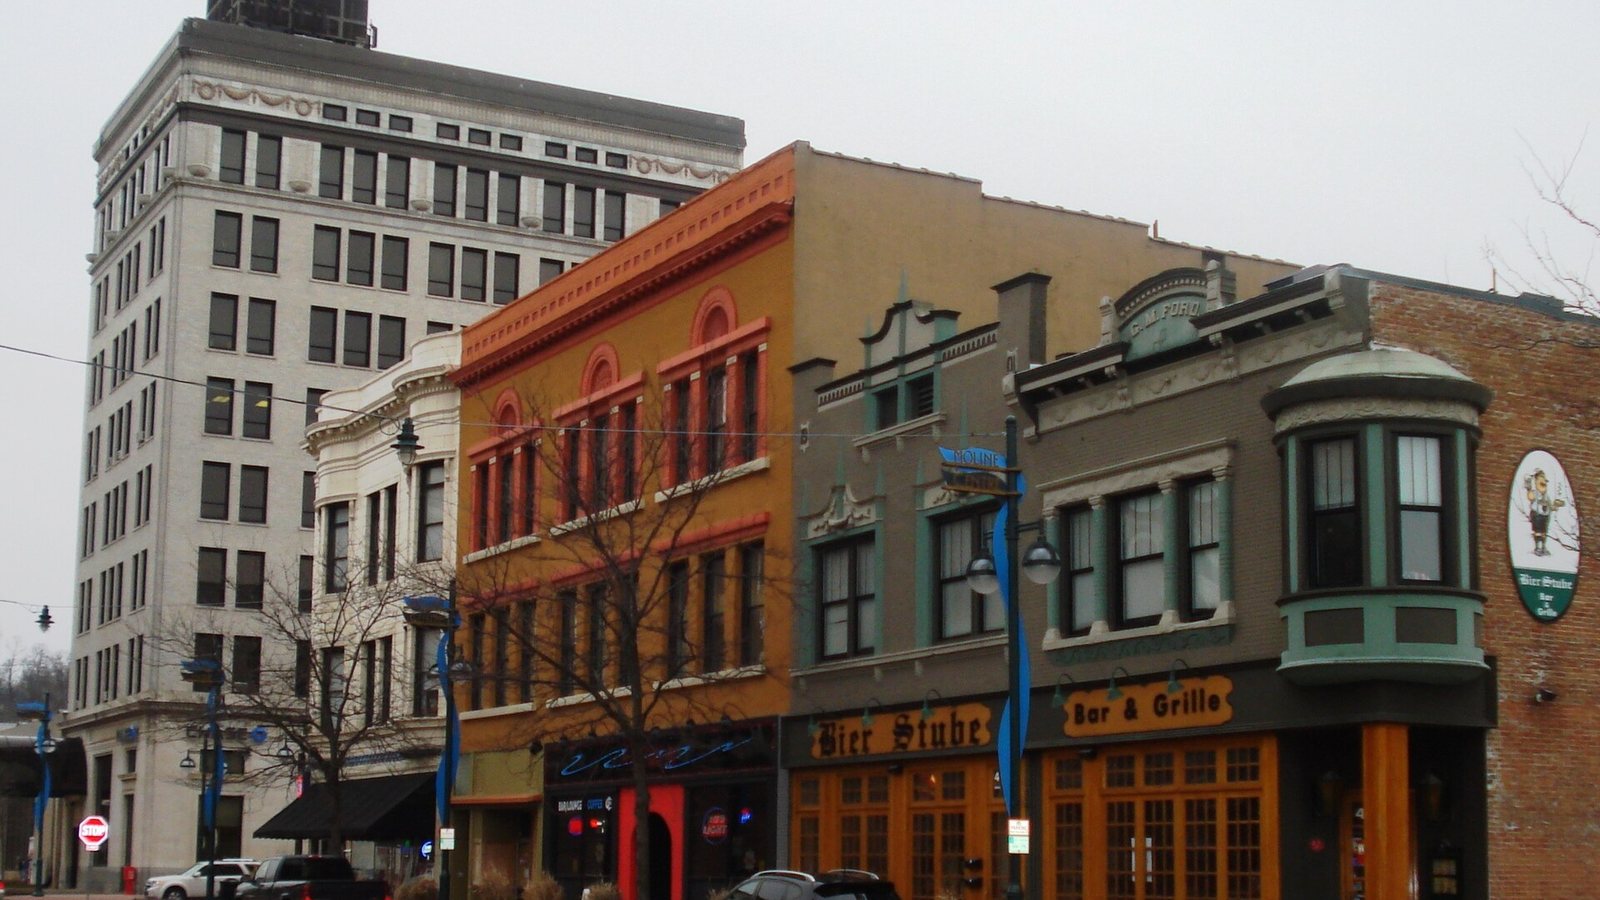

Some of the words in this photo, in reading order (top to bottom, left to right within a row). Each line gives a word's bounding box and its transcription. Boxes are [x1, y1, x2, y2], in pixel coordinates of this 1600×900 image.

[954, 450, 999, 467] MOLINE
[1519, 573, 1541, 587] Bier
[1073, 703, 1111, 726] Bar
[1123, 696, 1139, 721] &
[1153, 687, 1221, 718] Grille
[819, 719, 873, 756] Bier
[893, 711, 982, 751] Stube
[81, 824, 106, 837] STOP
